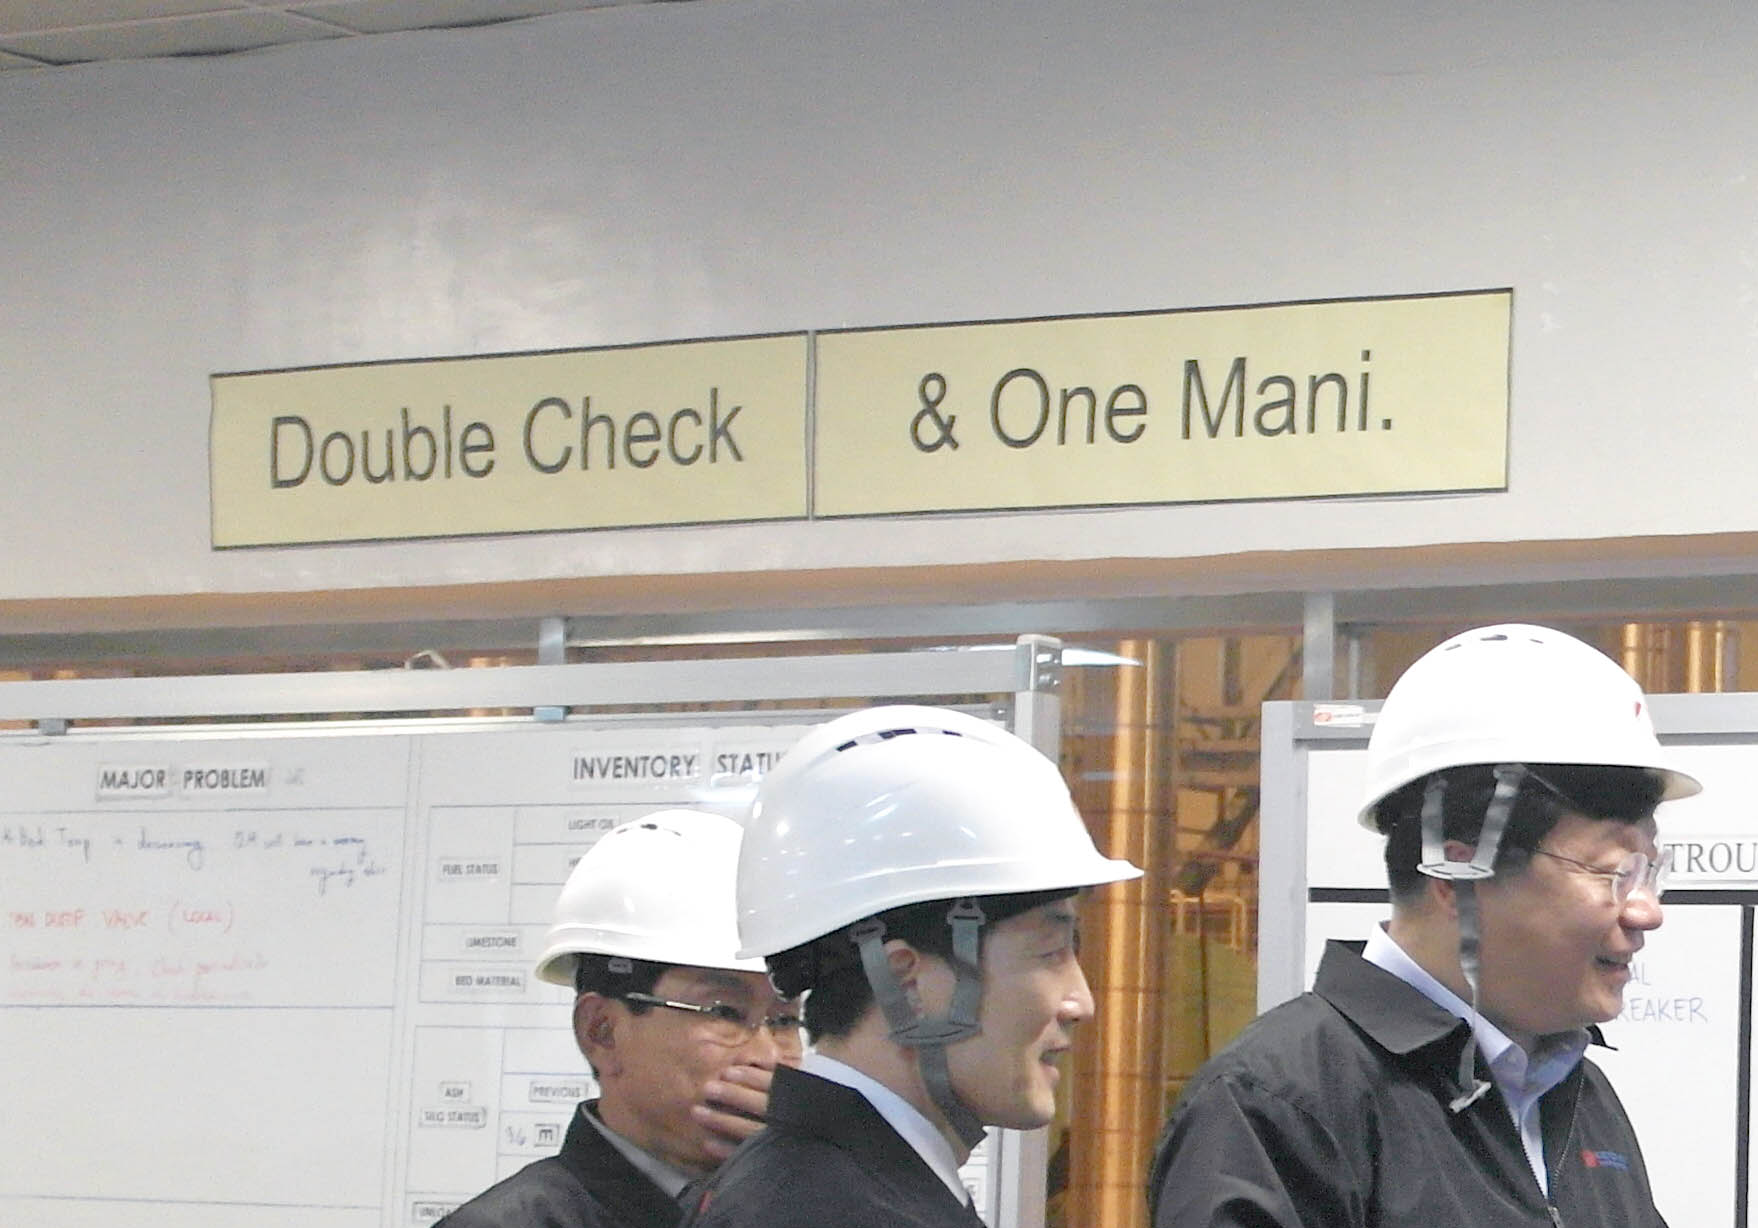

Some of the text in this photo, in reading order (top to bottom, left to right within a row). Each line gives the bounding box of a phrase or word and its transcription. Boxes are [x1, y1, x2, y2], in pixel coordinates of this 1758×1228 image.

[270, 350, 1392, 489] Double Check & One Mani.
[100, 769, 165, 790] MAJOR
[183, 768, 265, 790] PROBLEM
[574, 752, 788, 779] INVENTORY STATU
